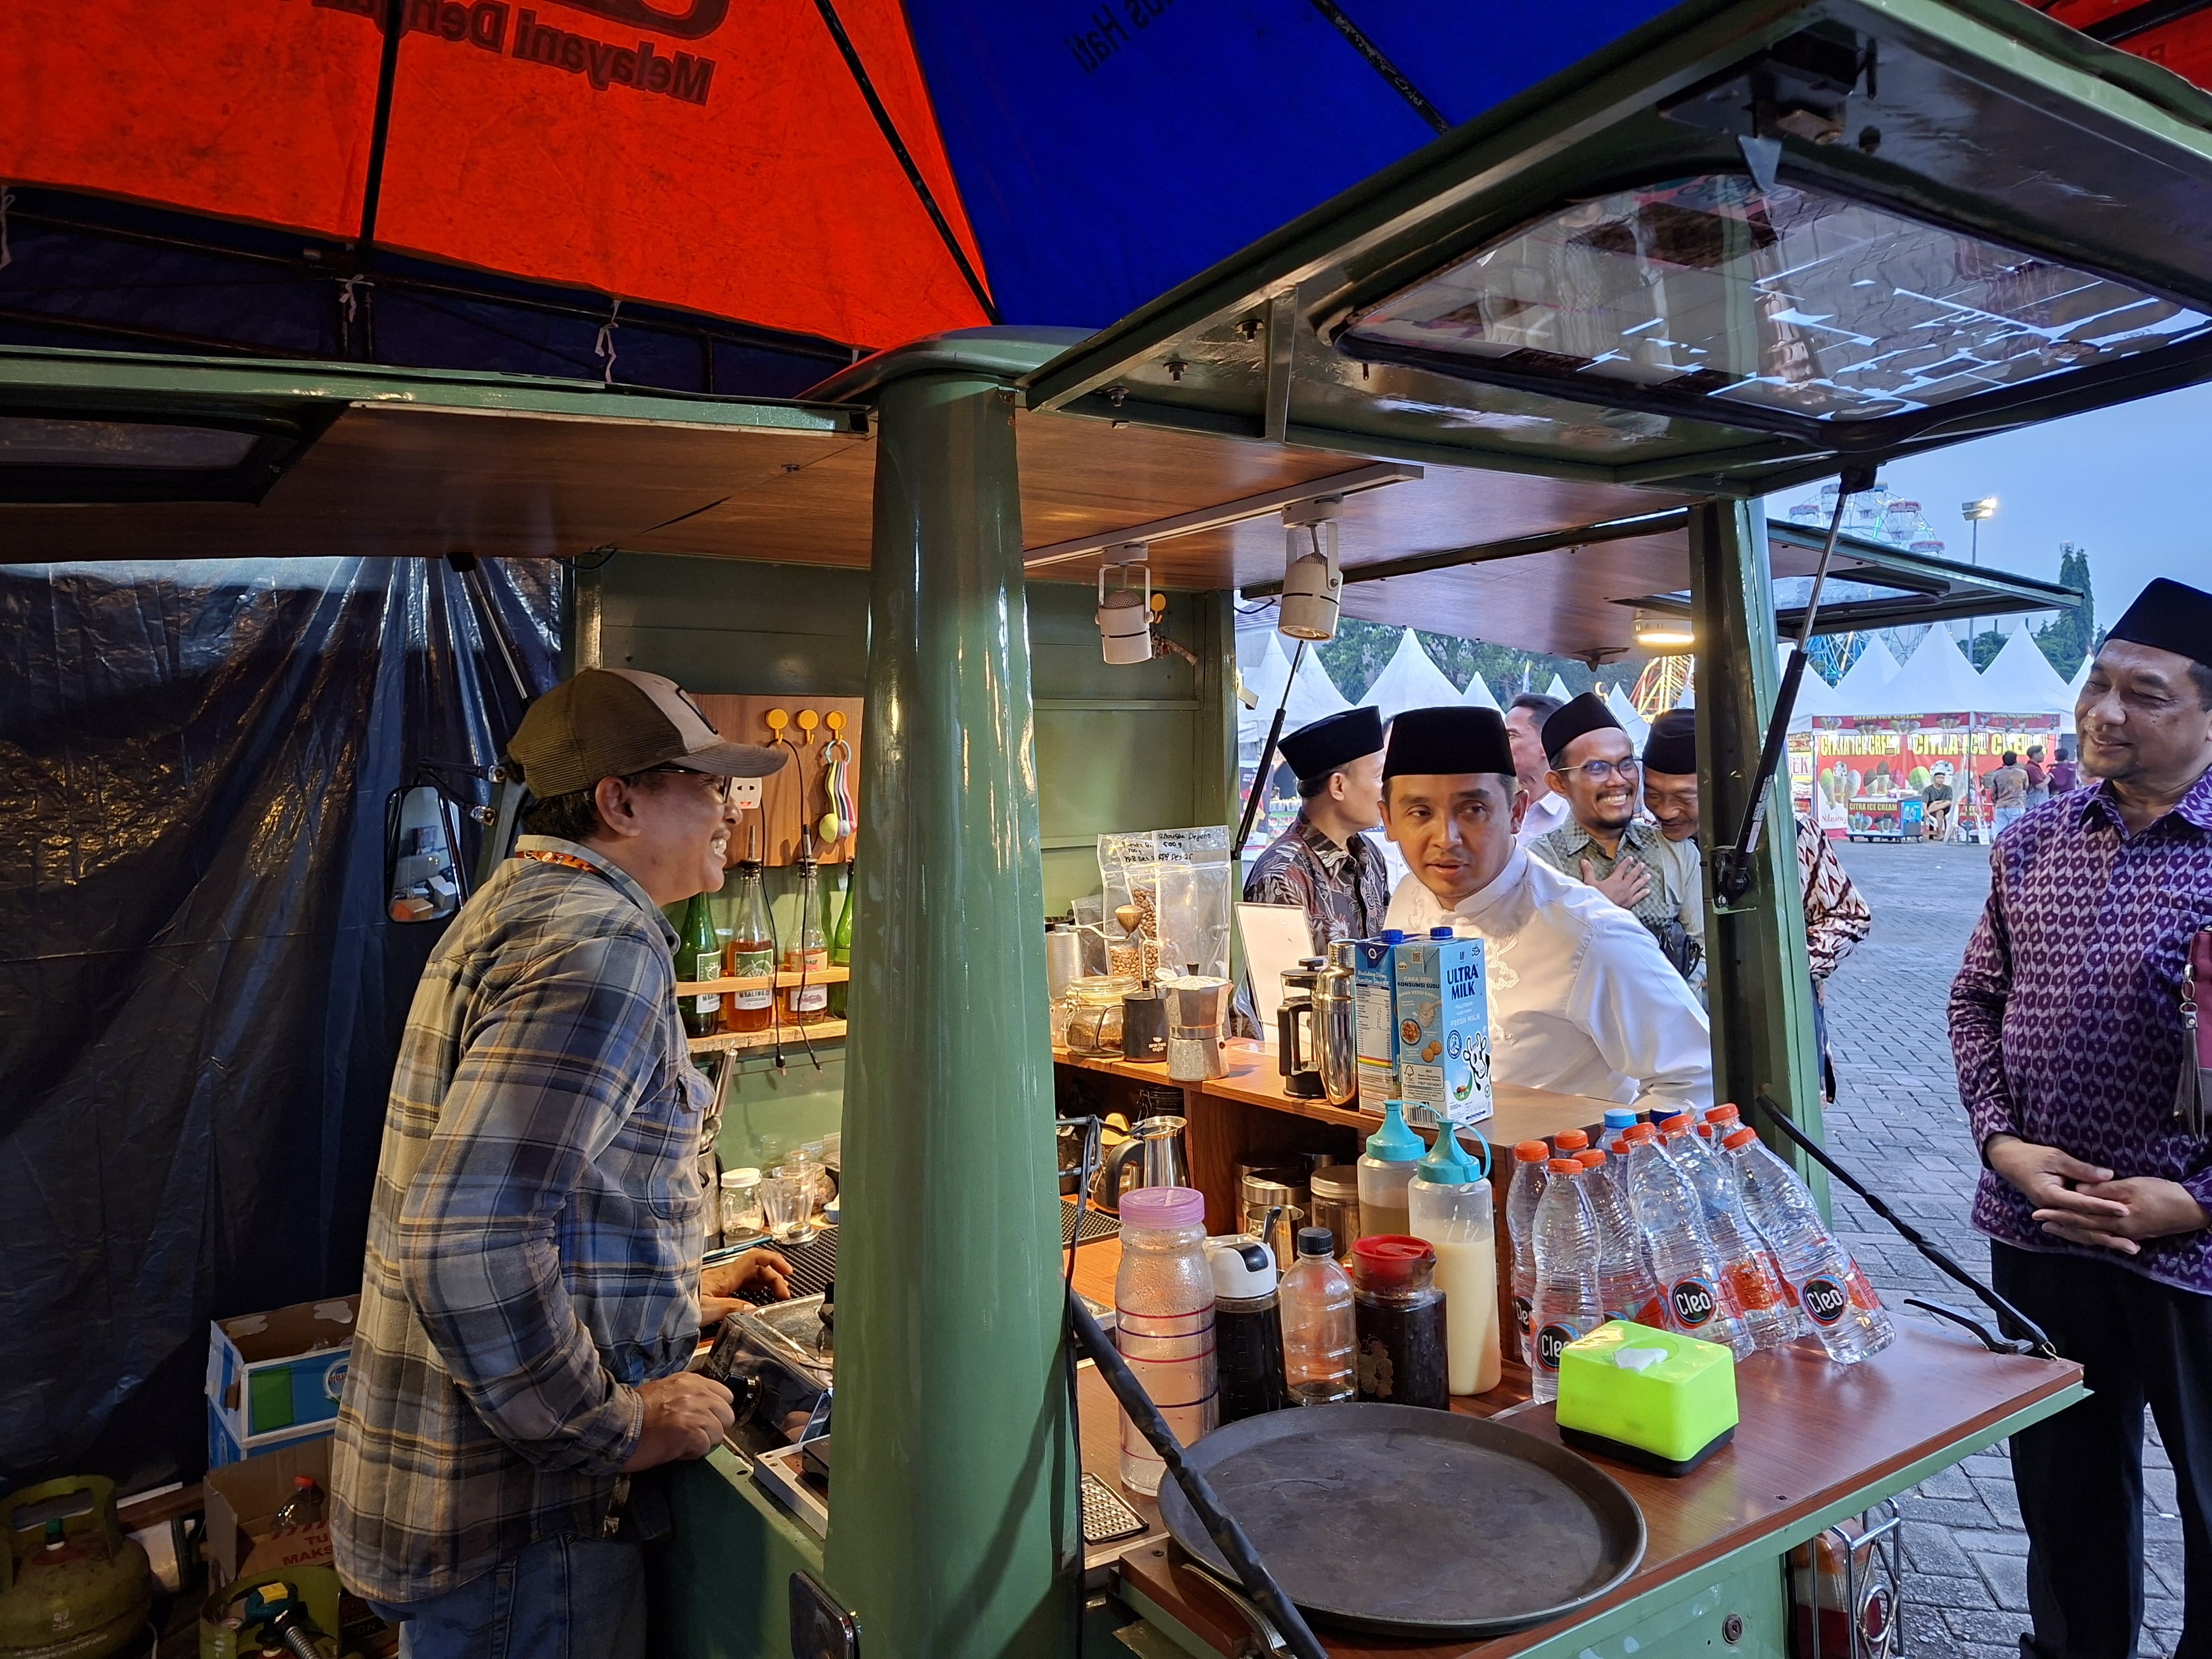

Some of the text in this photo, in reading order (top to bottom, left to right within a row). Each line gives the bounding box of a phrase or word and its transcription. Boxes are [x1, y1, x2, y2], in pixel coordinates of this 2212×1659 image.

[1447, 964, 1479, 985] ULTRA
[1452, 981, 1475, 1000] MILK
[1451, 1013, 1481, 1027] FRESH MILK
[1676, 1292, 1712, 1315] Cleo
[1806, 1289, 1843, 1313] Cleo
[1515, 1301, 1529, 1325] Cle
[1541, 1334, 1571, 1358] Cle
